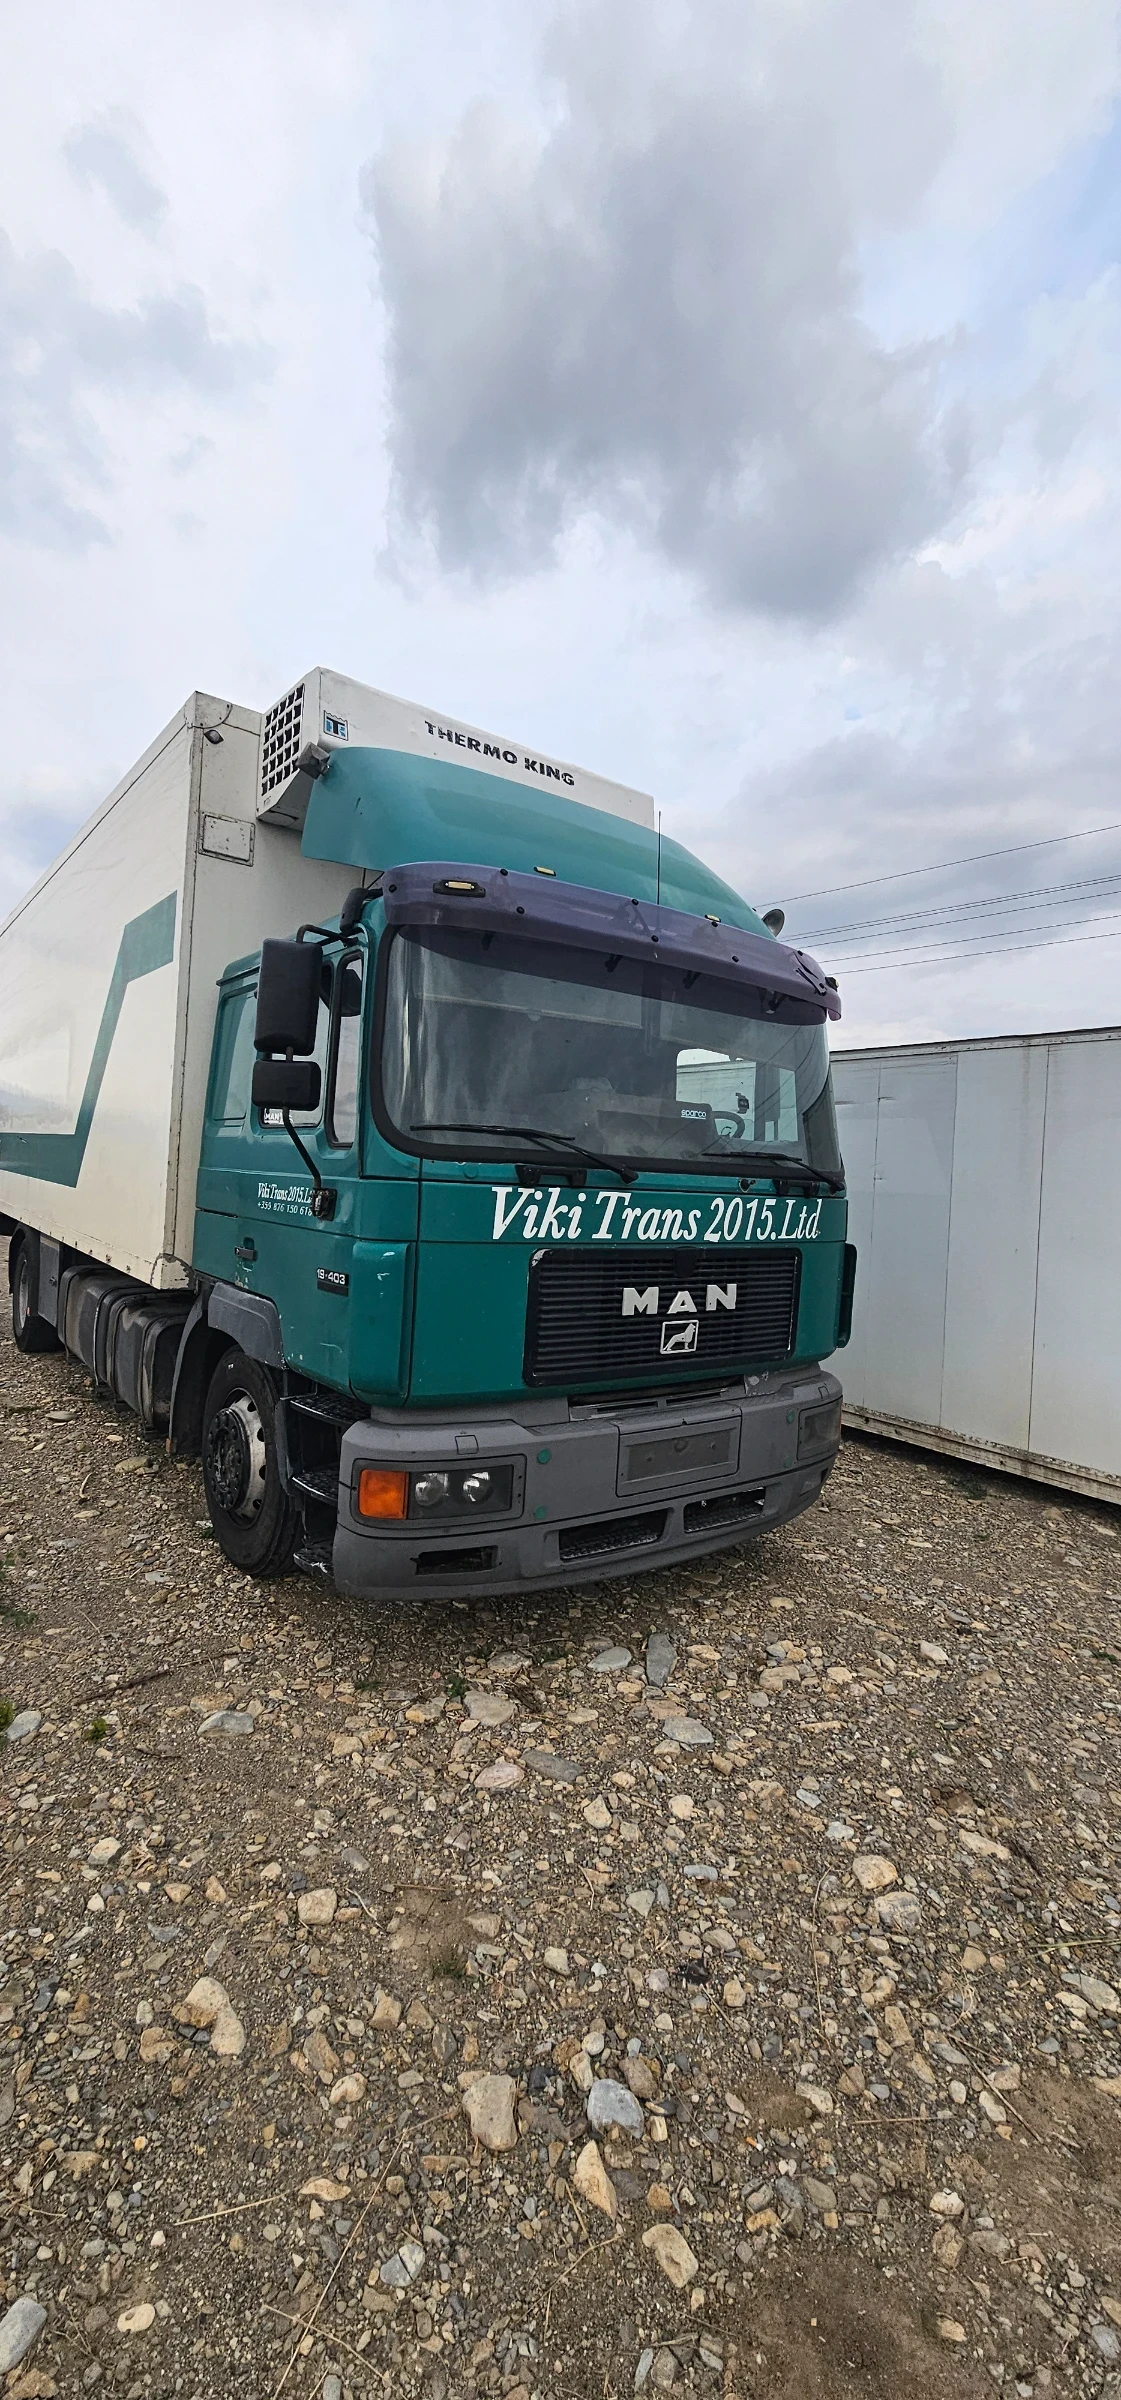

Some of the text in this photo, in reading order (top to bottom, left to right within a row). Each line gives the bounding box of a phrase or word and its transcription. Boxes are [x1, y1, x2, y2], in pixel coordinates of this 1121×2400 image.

[424, 720, 575, 786] THERMO KING
[287, 1186, 313, 1204] 2015.L
[491, 1186, 823, 1243] Viki Trans 2015.Ltd
[621, 1283, 738, 1317] MAN
